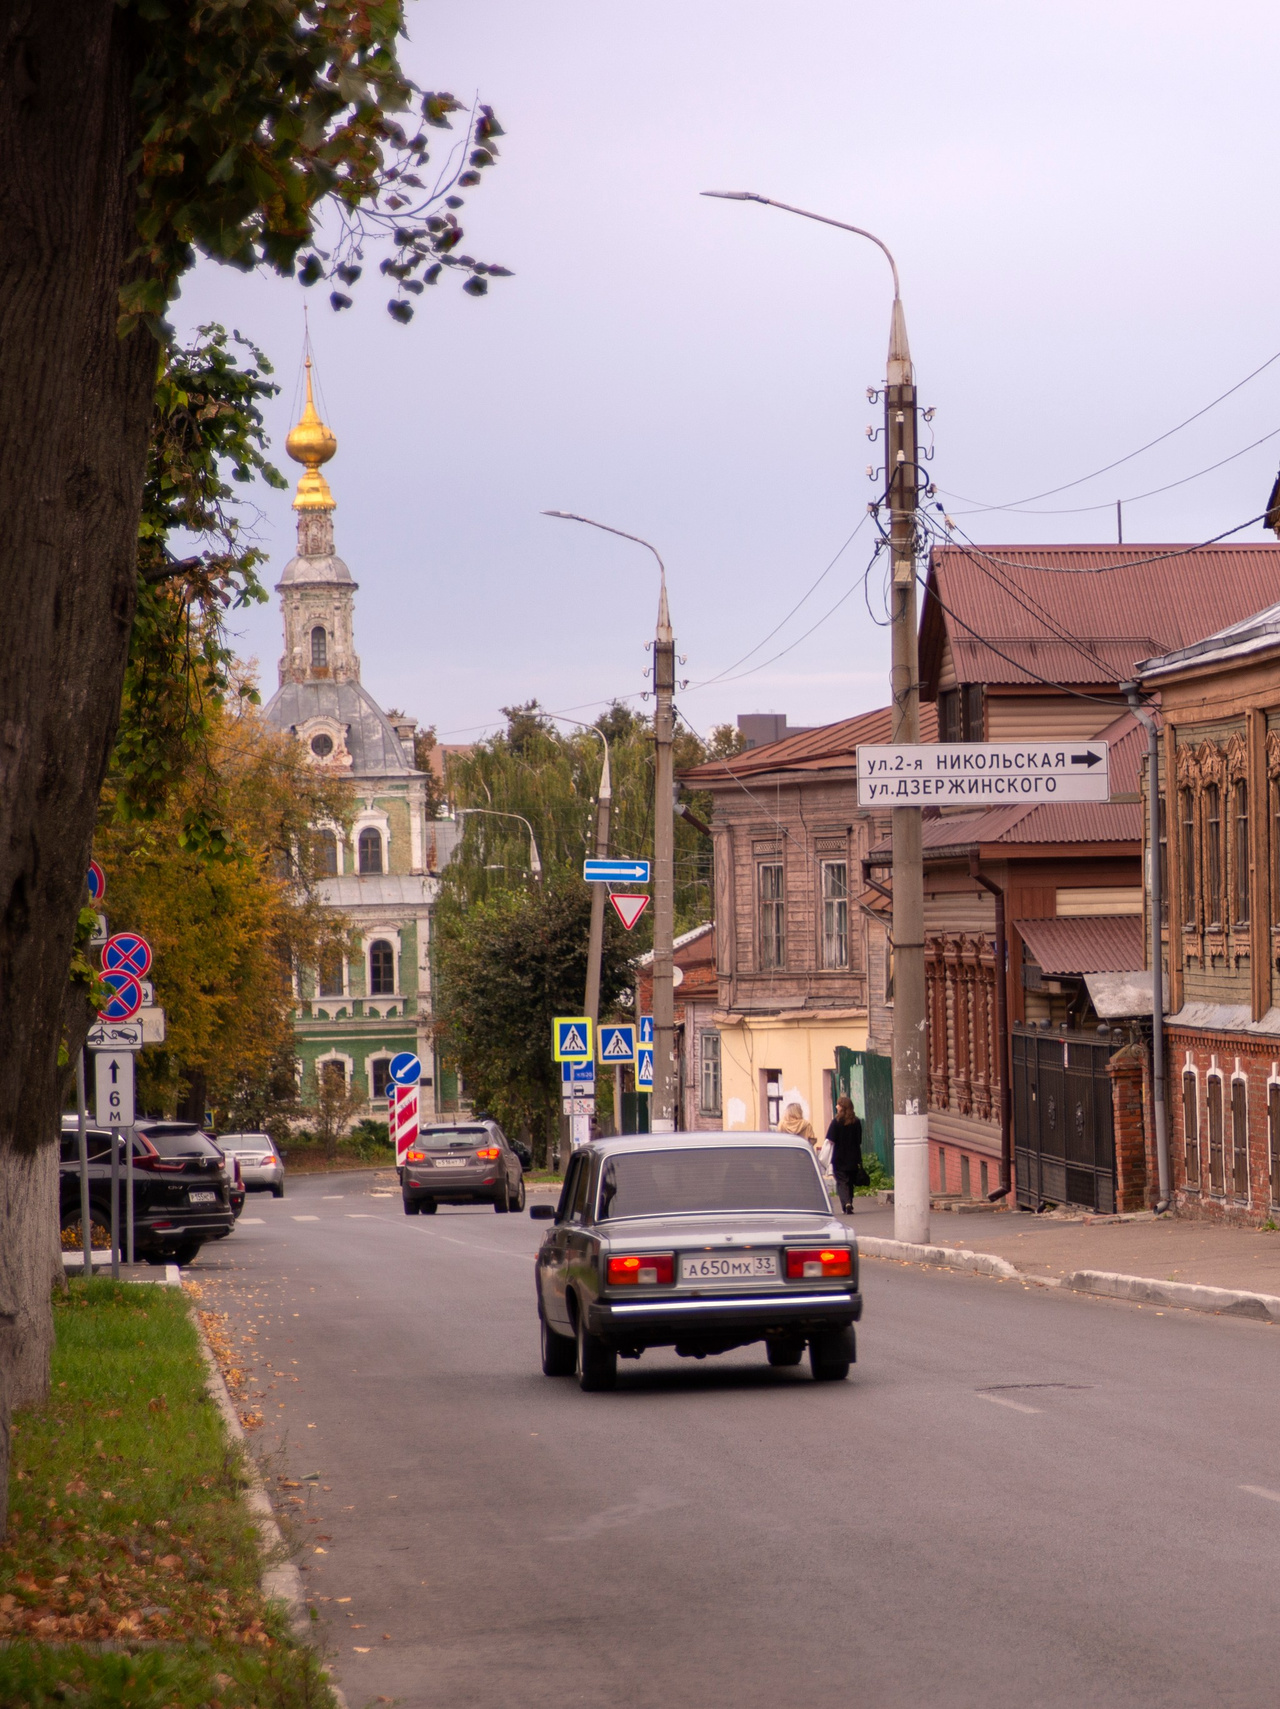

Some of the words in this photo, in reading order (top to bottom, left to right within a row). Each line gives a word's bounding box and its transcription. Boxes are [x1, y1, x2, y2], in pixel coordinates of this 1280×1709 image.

[936, 752, 1065, 770] НИКОЛЬСКАЯ
[109, 1091, 121, 1107] 6
[755, 1257, 771, 1270] 33
